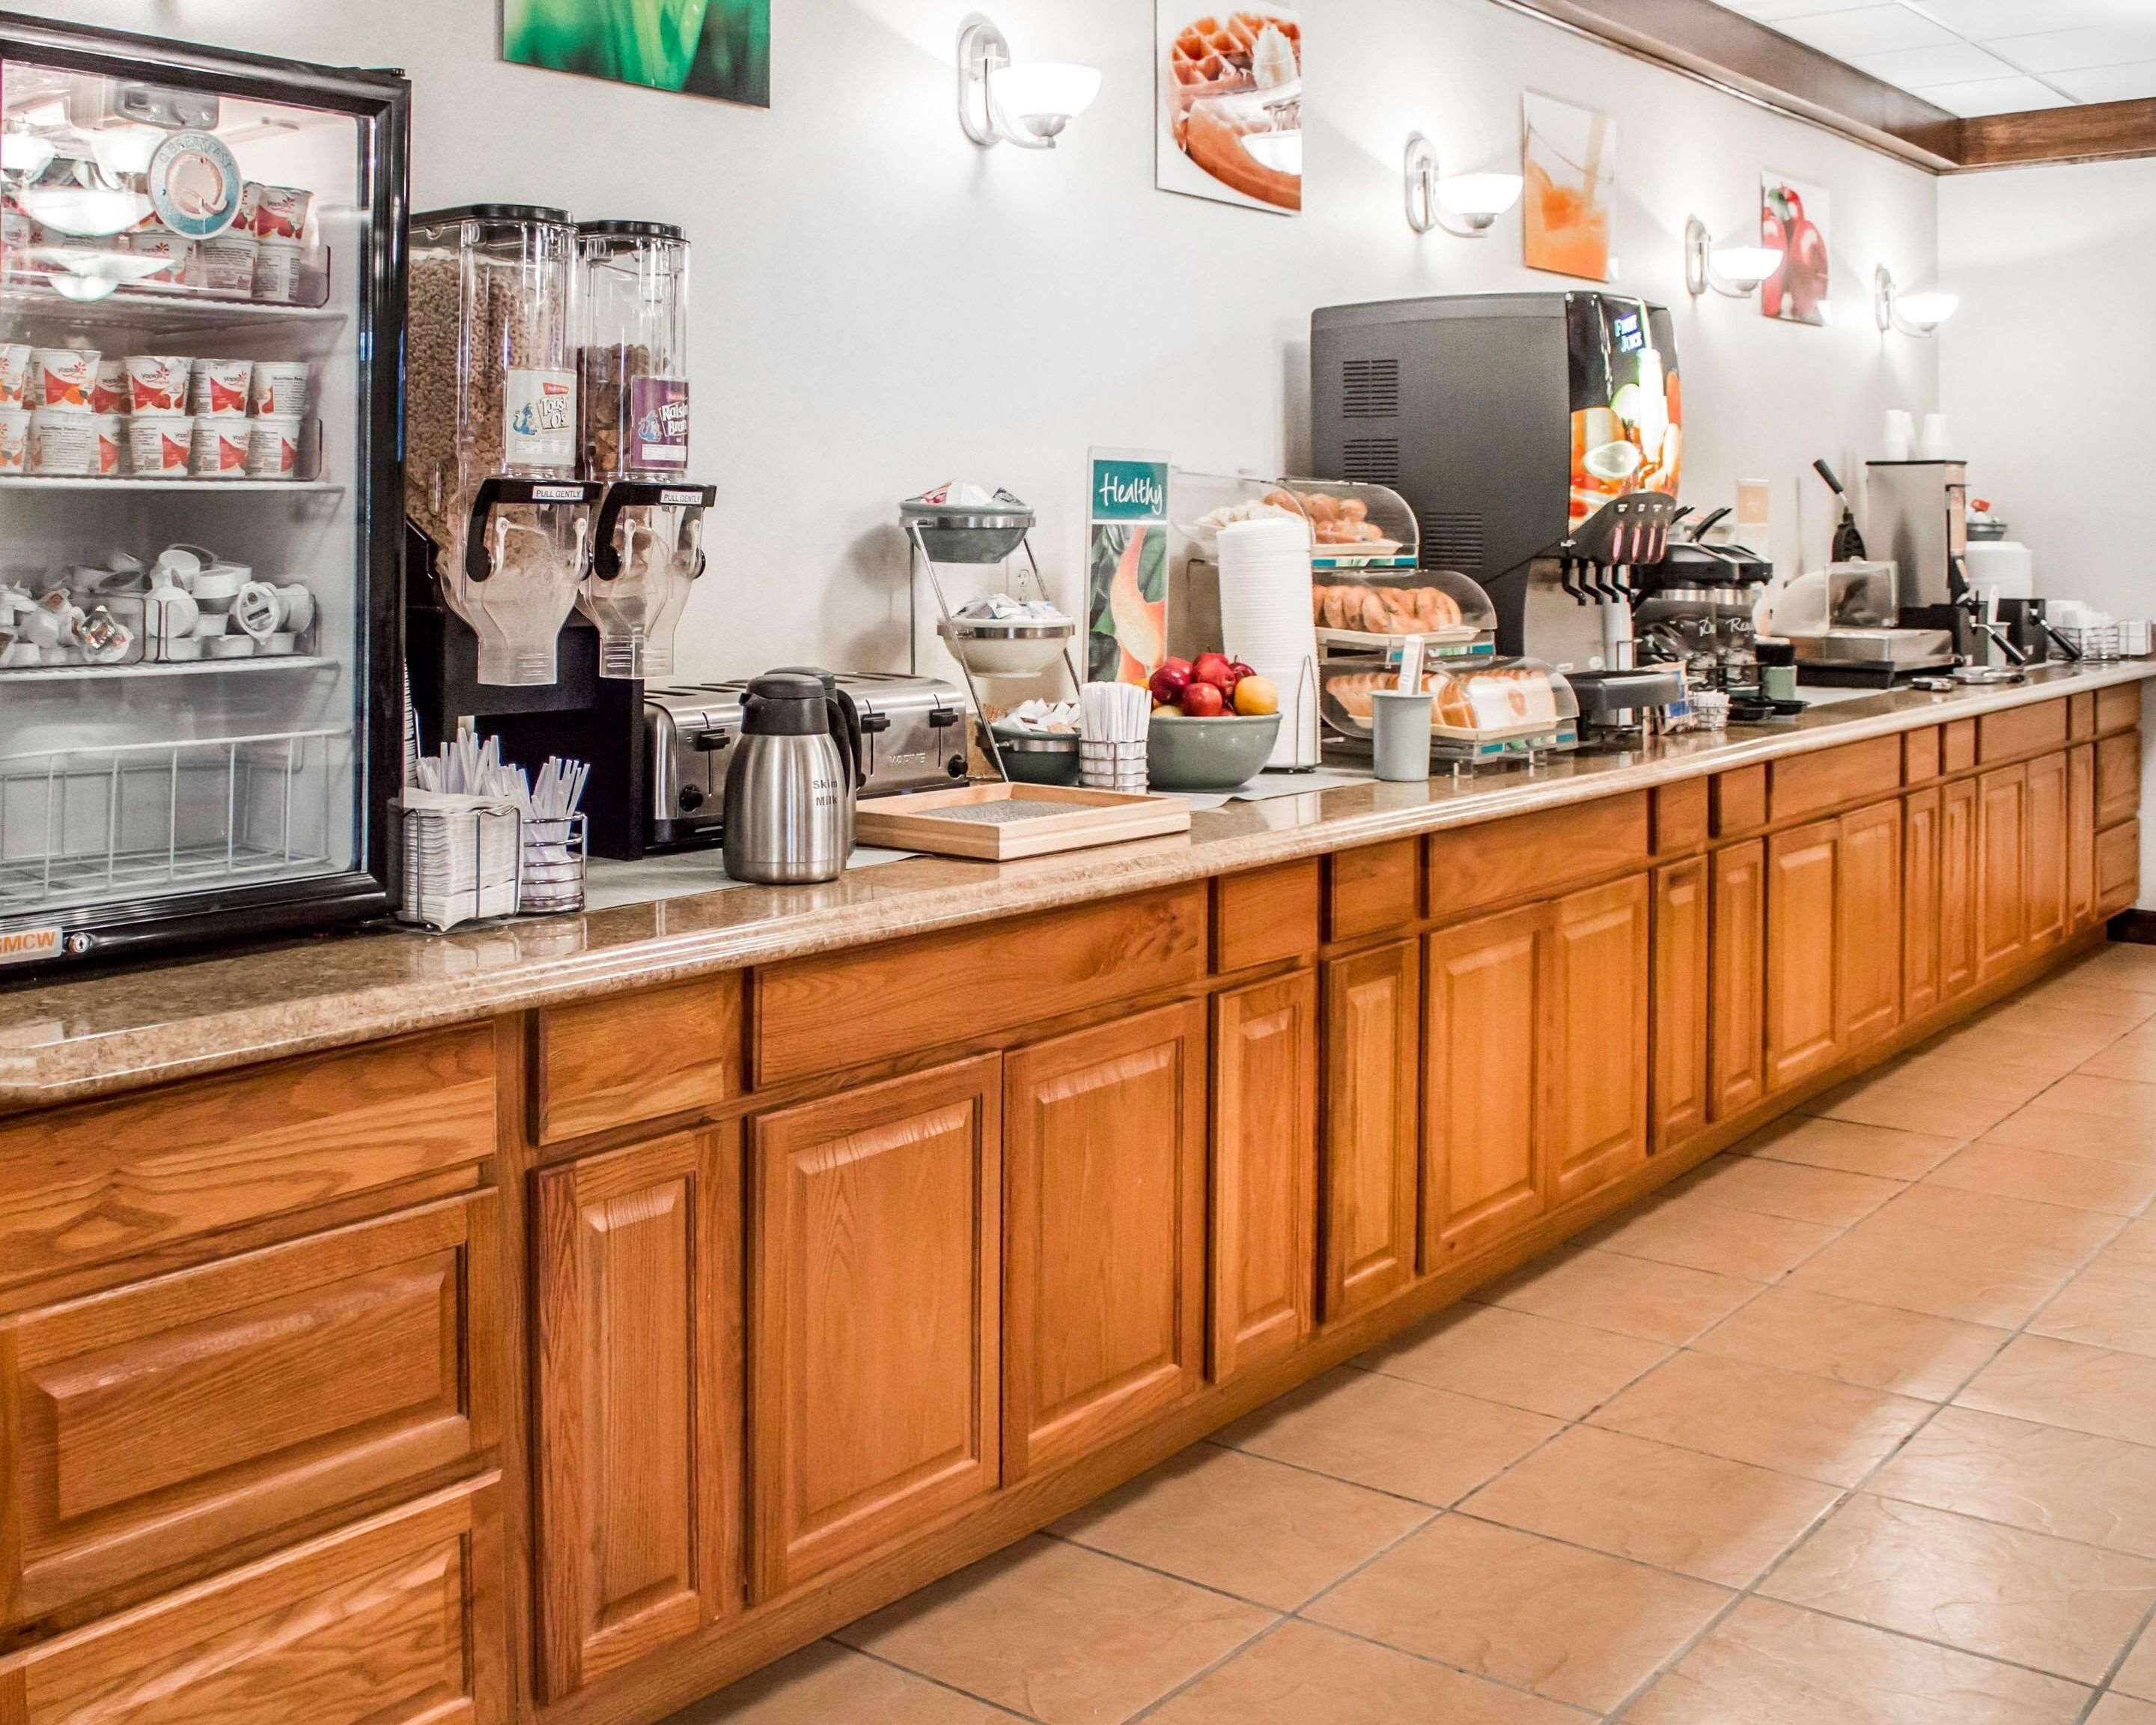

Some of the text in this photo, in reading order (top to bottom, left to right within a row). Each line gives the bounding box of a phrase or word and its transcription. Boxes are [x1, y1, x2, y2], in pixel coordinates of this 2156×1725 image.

[1099, 472, 1163, 515] Healthy
[813, 778, 838, 789] Skim
[816, 794, 838, 806] Milk
